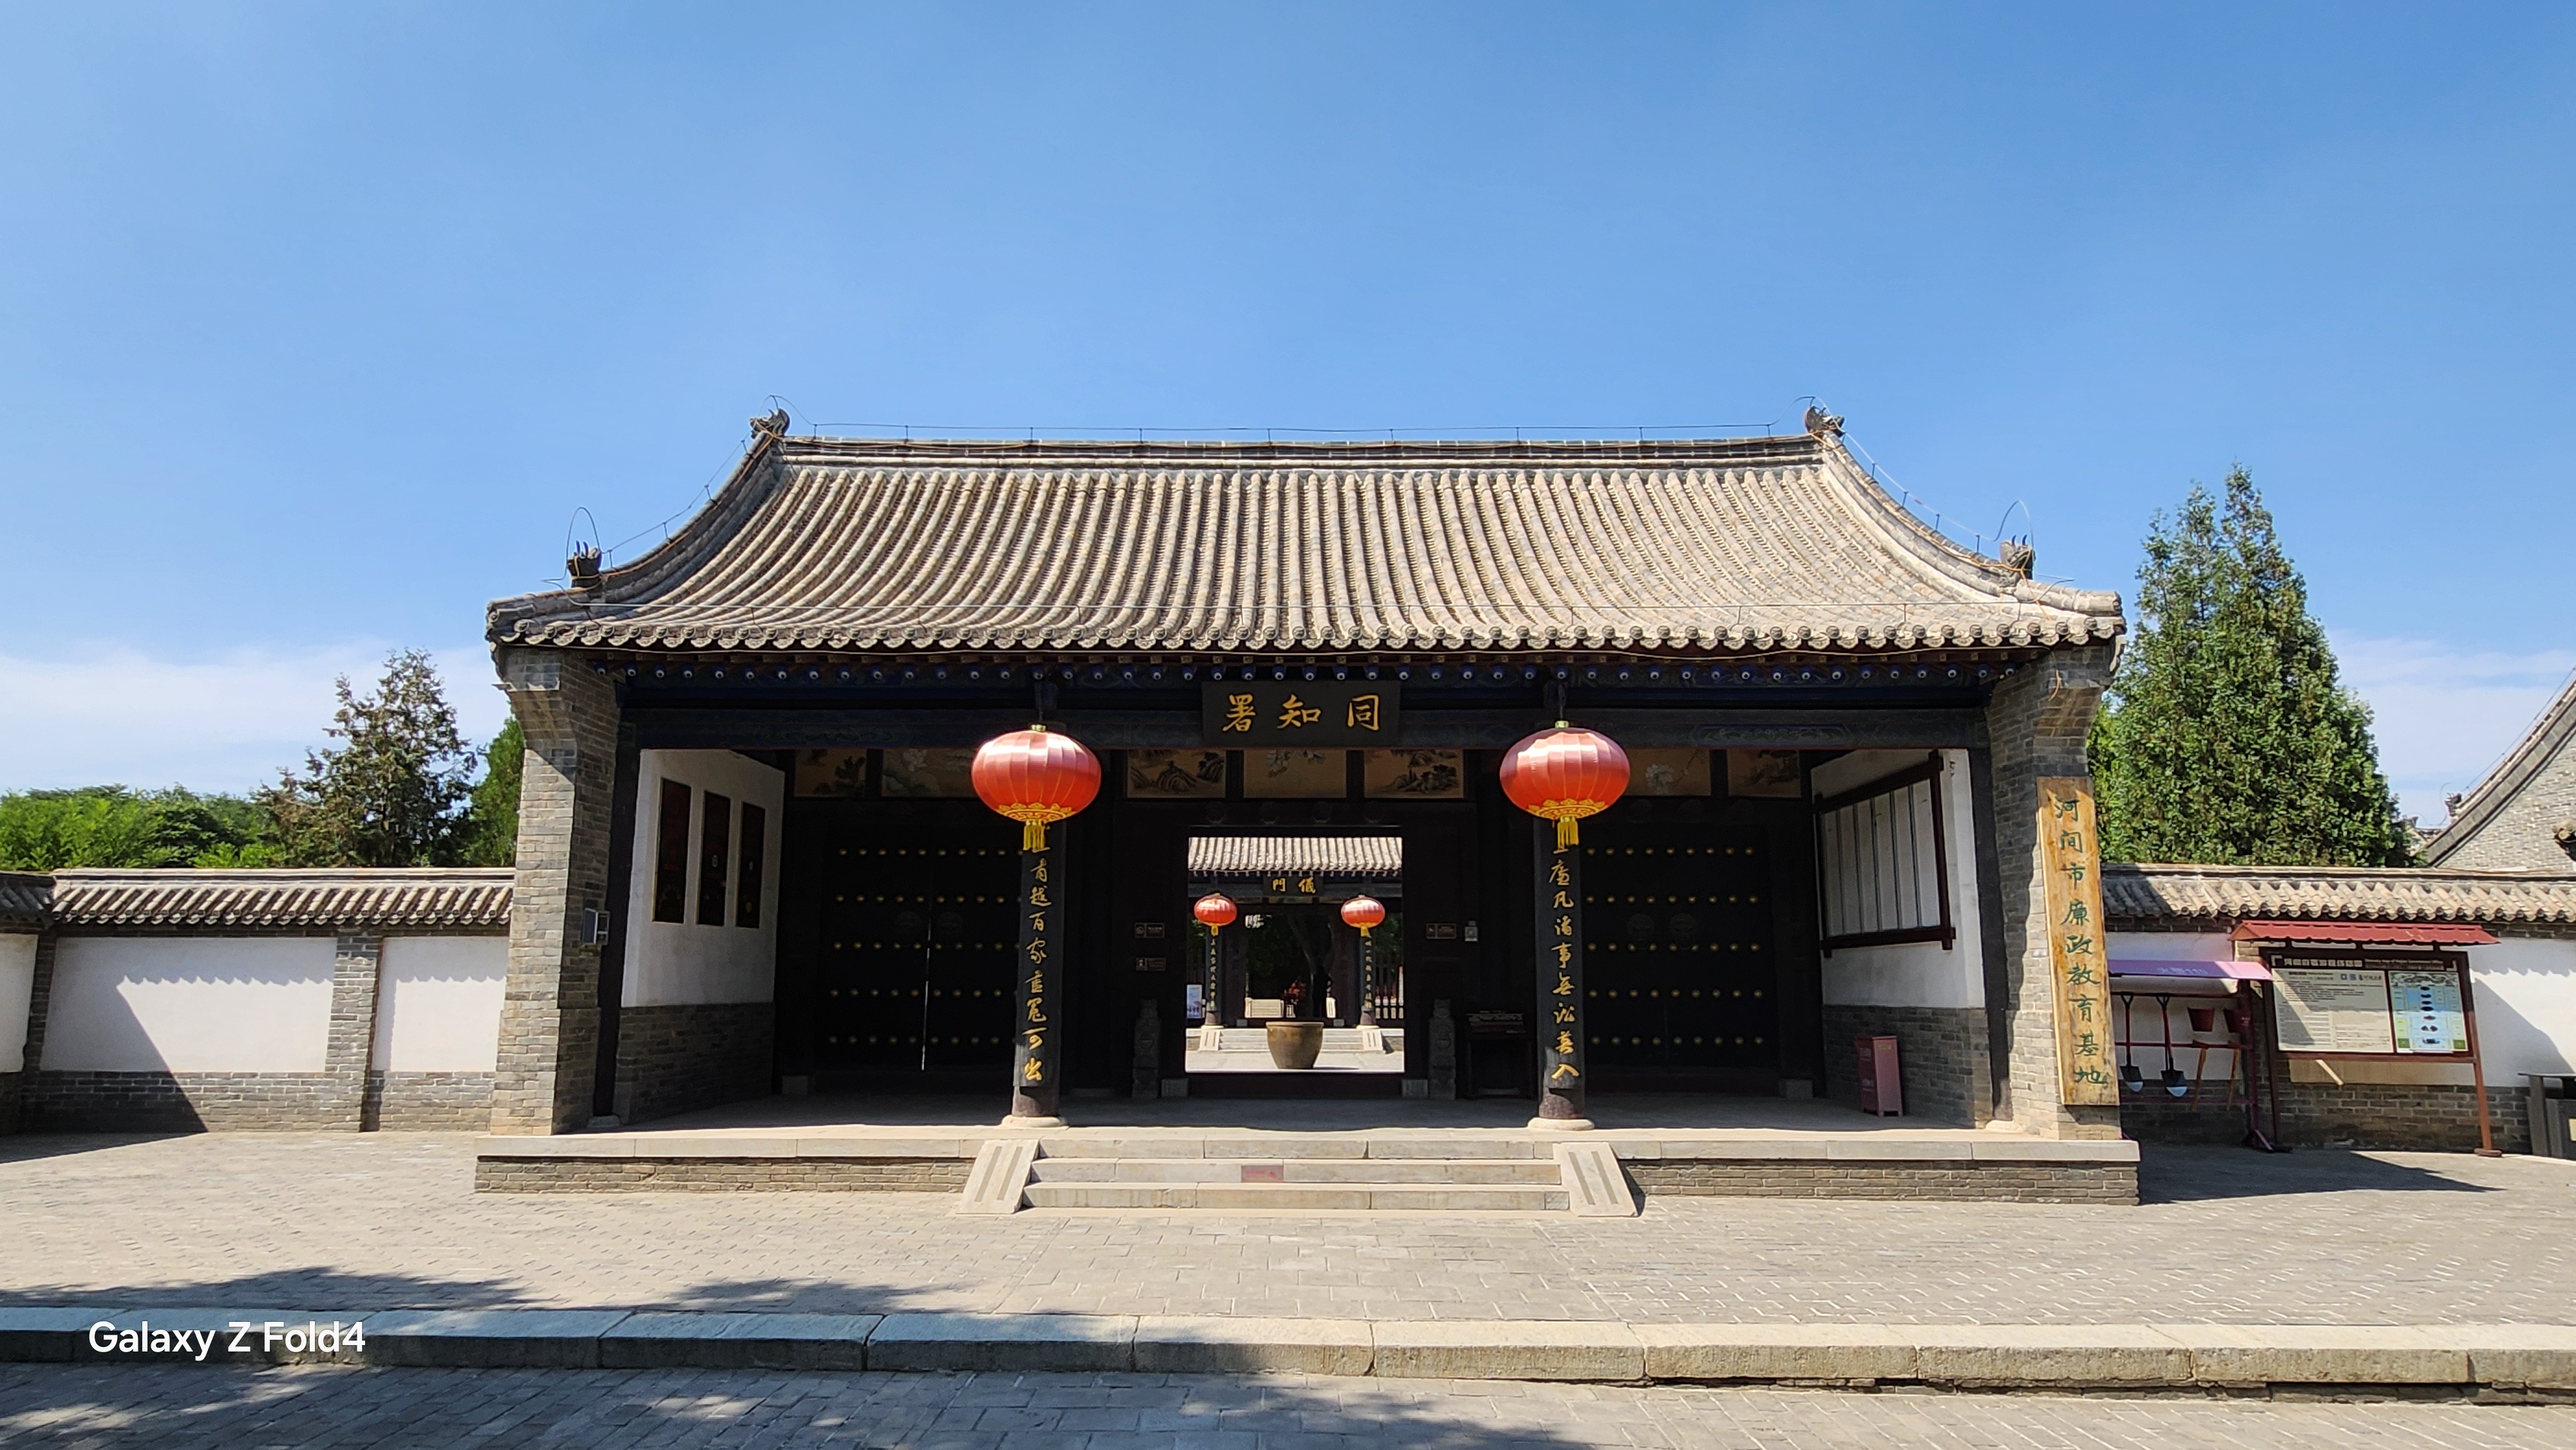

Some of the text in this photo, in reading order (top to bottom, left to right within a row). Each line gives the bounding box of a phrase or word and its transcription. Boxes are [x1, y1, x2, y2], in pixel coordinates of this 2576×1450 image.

[1222, 692, 1381, 733] 同知署
[1272, 876, 1316, 894] 儀門
[2054, 796, 2108, 1085] 河间市廉政教育基地
